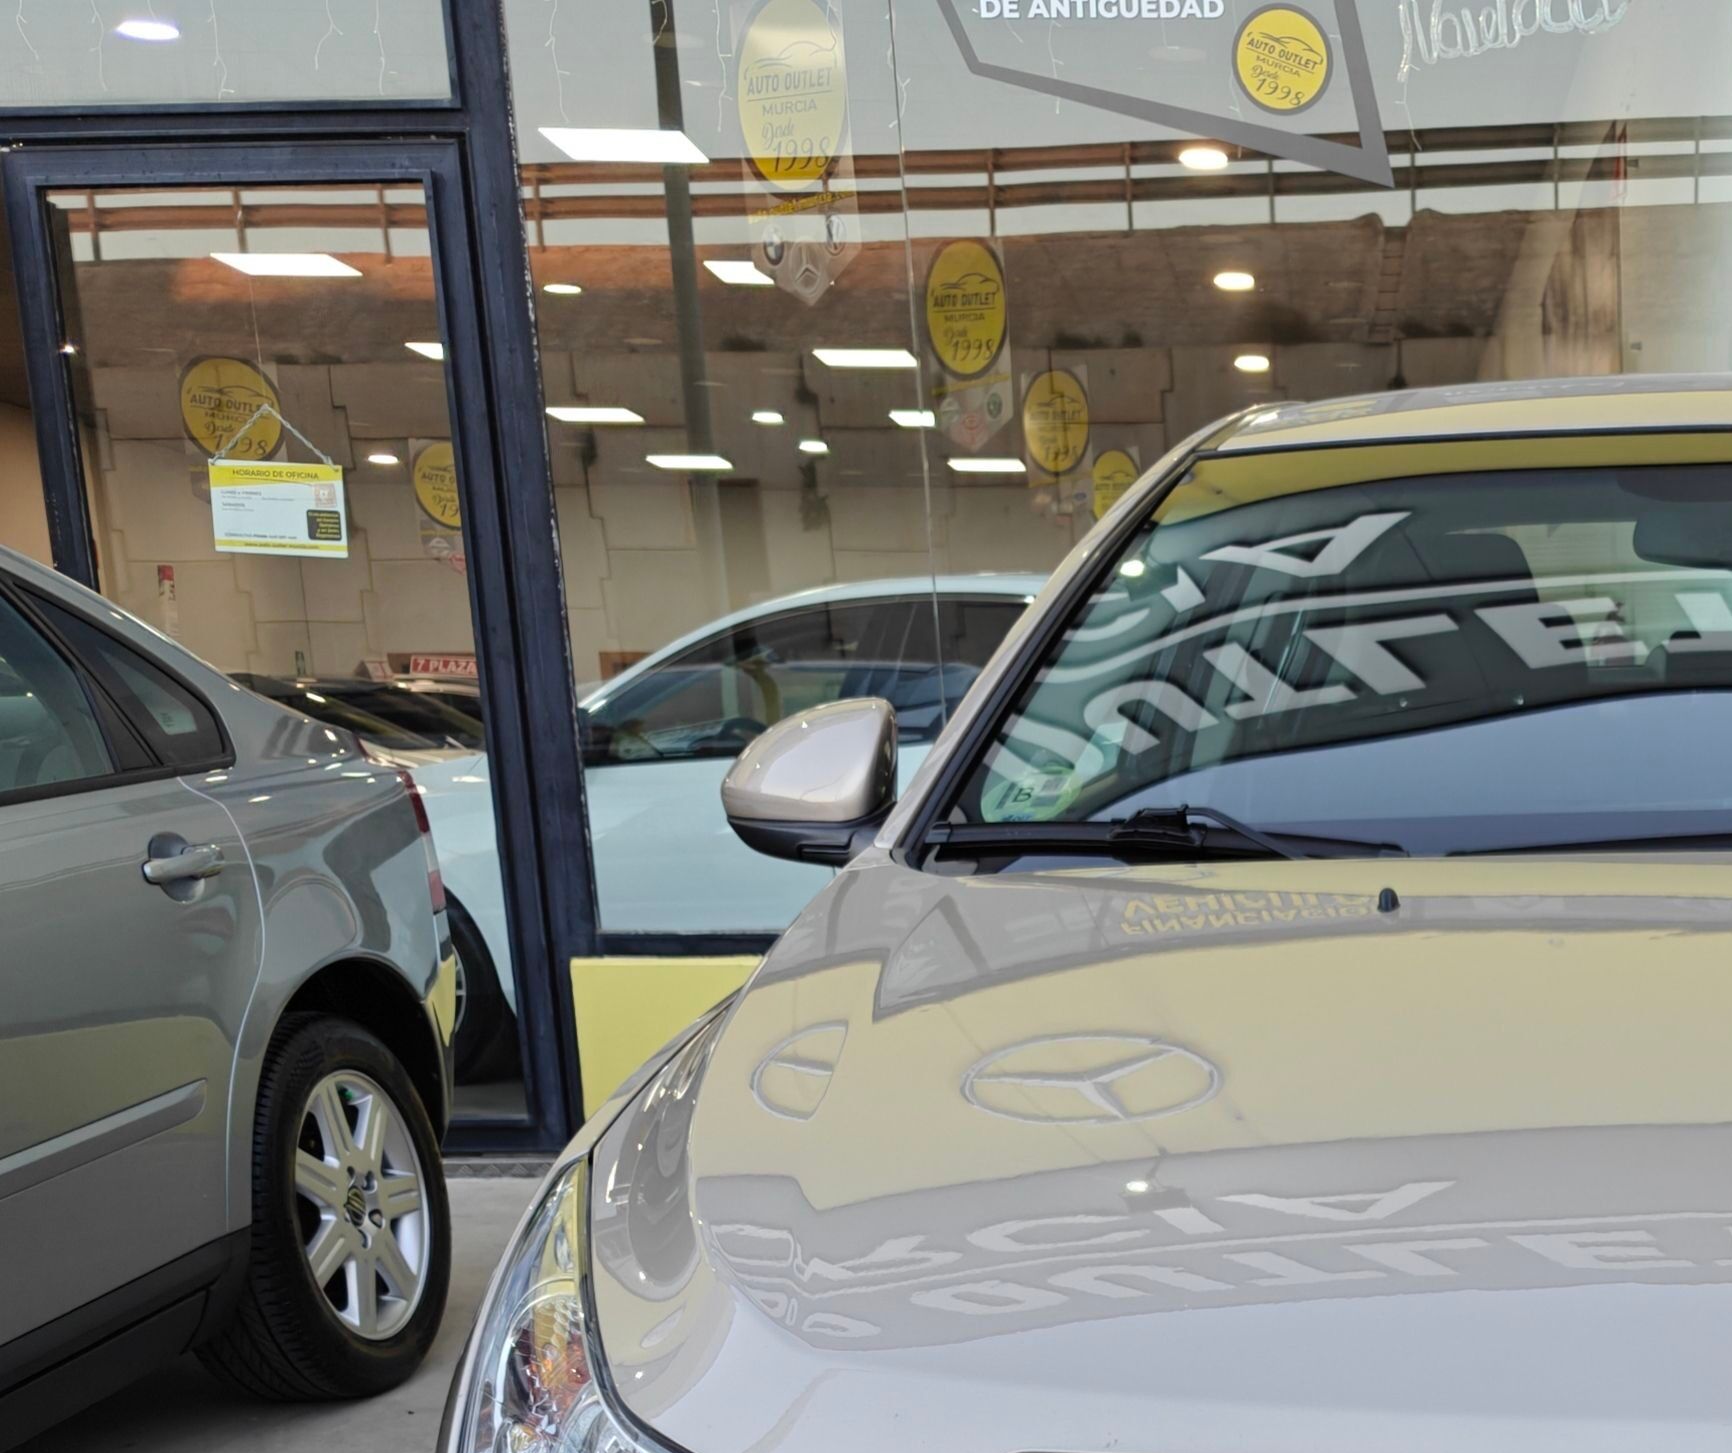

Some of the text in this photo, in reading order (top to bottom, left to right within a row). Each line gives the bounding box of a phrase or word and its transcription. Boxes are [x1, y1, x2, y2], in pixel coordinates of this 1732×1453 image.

[980, 0, 1020, 18] DE
[1247, 36, 1319, 71] AUTO OUTLET
[1255, 54, 1301, 77] MURCIA
[747, 67, 833, 96] AUTO OUTLET
[1255, 77, 1305, 107] 1998
[761, 98, 818, 116] MURCIA
[772, 136, 830, 173] 1998
[932, 291, 997, 308] AUTO OUTLET
[951, 339, 995, 362] 1998
[189, 394, 221, 408] AUTO
[212, 433, 269, 457] 198
[232, 469, 271, 479] HORARIO
[285, 471, 319, 480] OFICINA
[430, 660, 477, 673] PLAZA
